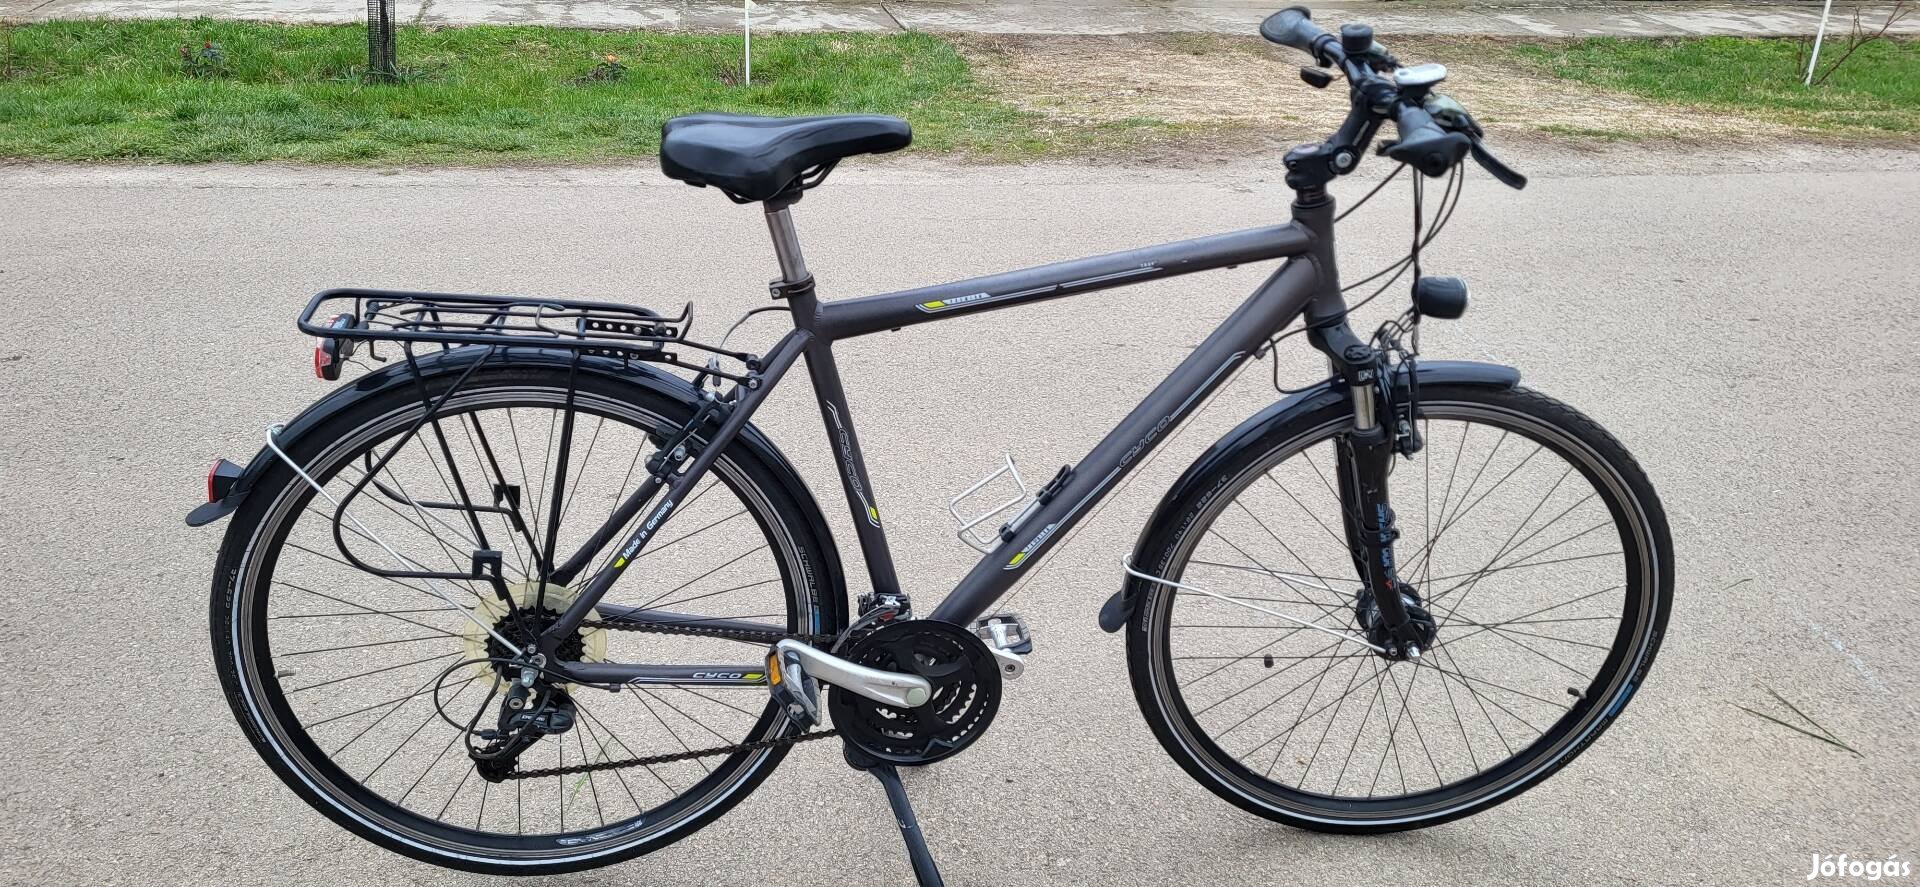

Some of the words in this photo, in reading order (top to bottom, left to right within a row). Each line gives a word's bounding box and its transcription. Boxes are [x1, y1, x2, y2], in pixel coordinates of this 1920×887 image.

[1119, 415, 1171, 468] CYCO
[622, 538, 641, 560] Made
[639, 530, 648, 540] in
[646, 499, 674, 530] Germany
[692, 671, 742, 679] CYCO
